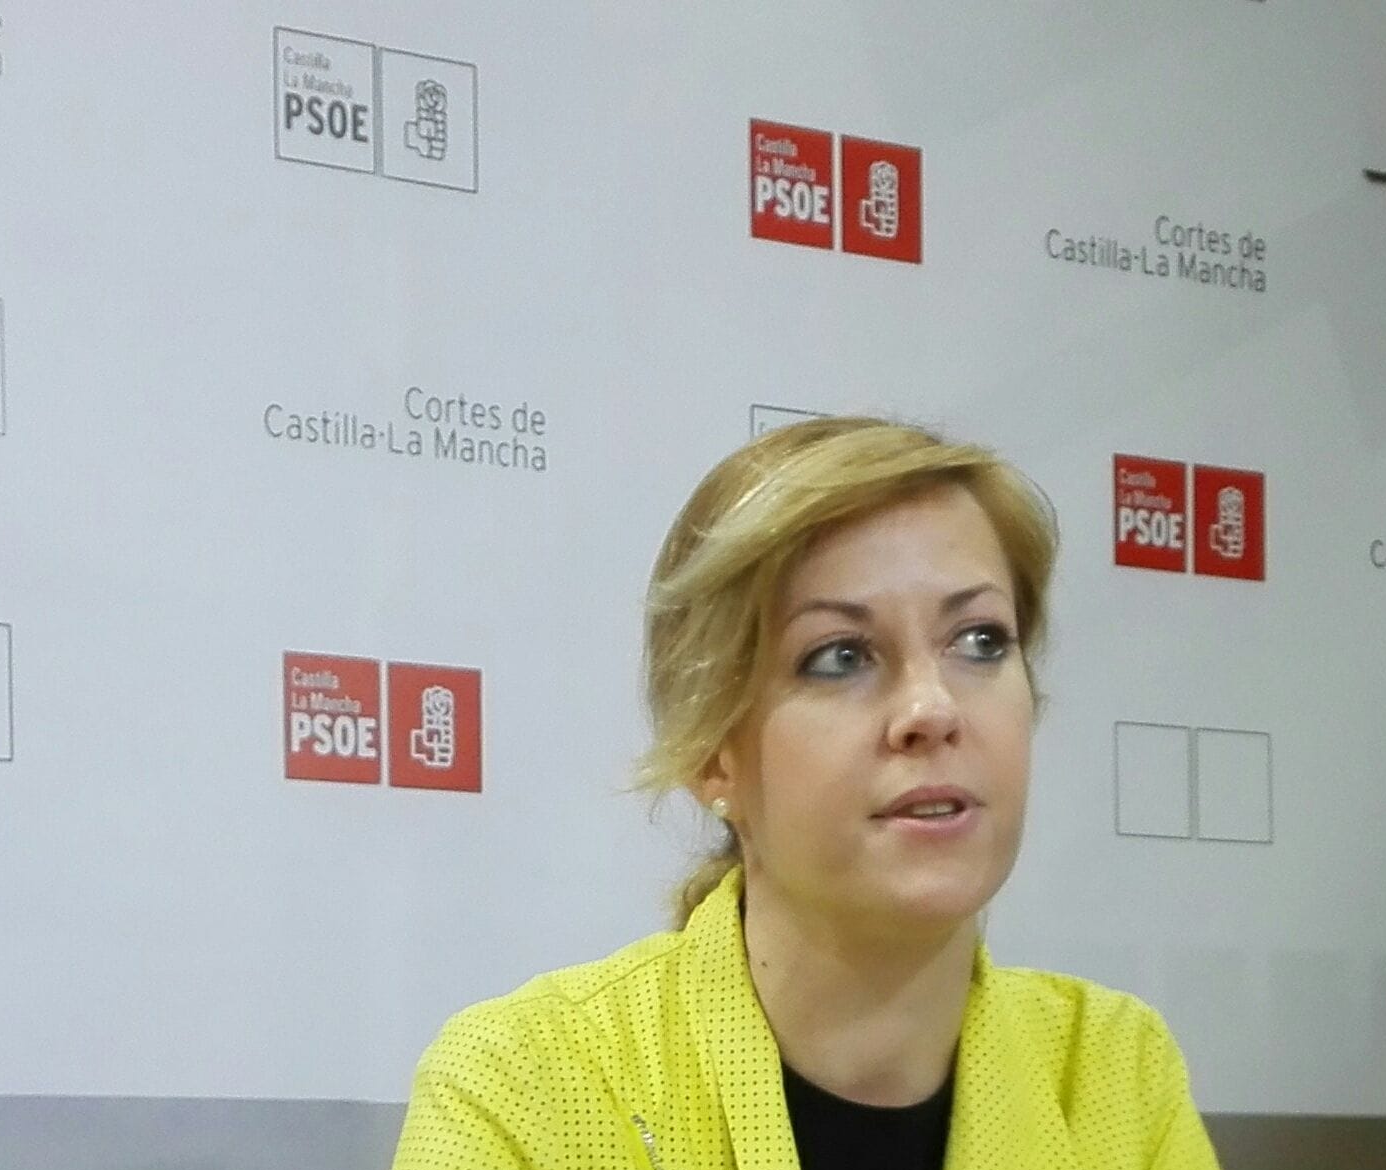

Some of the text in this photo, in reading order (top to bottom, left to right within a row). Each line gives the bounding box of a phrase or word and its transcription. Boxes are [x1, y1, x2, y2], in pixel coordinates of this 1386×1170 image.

[285, 92, 368, 143] PSOE
[755, 175, 830, 224] PSOE
[1045, 228, 1266, 292] Castilla-La Mancha
[1155, 215, 1266, 260] Cortes de
[405, 386, 546, 436] Cortes de
[264, 404, 546, 471] Castilla-La Mancha
[1119, 506, 1184, 549] PSOE
[291, 711, 377, 758] PSOE
